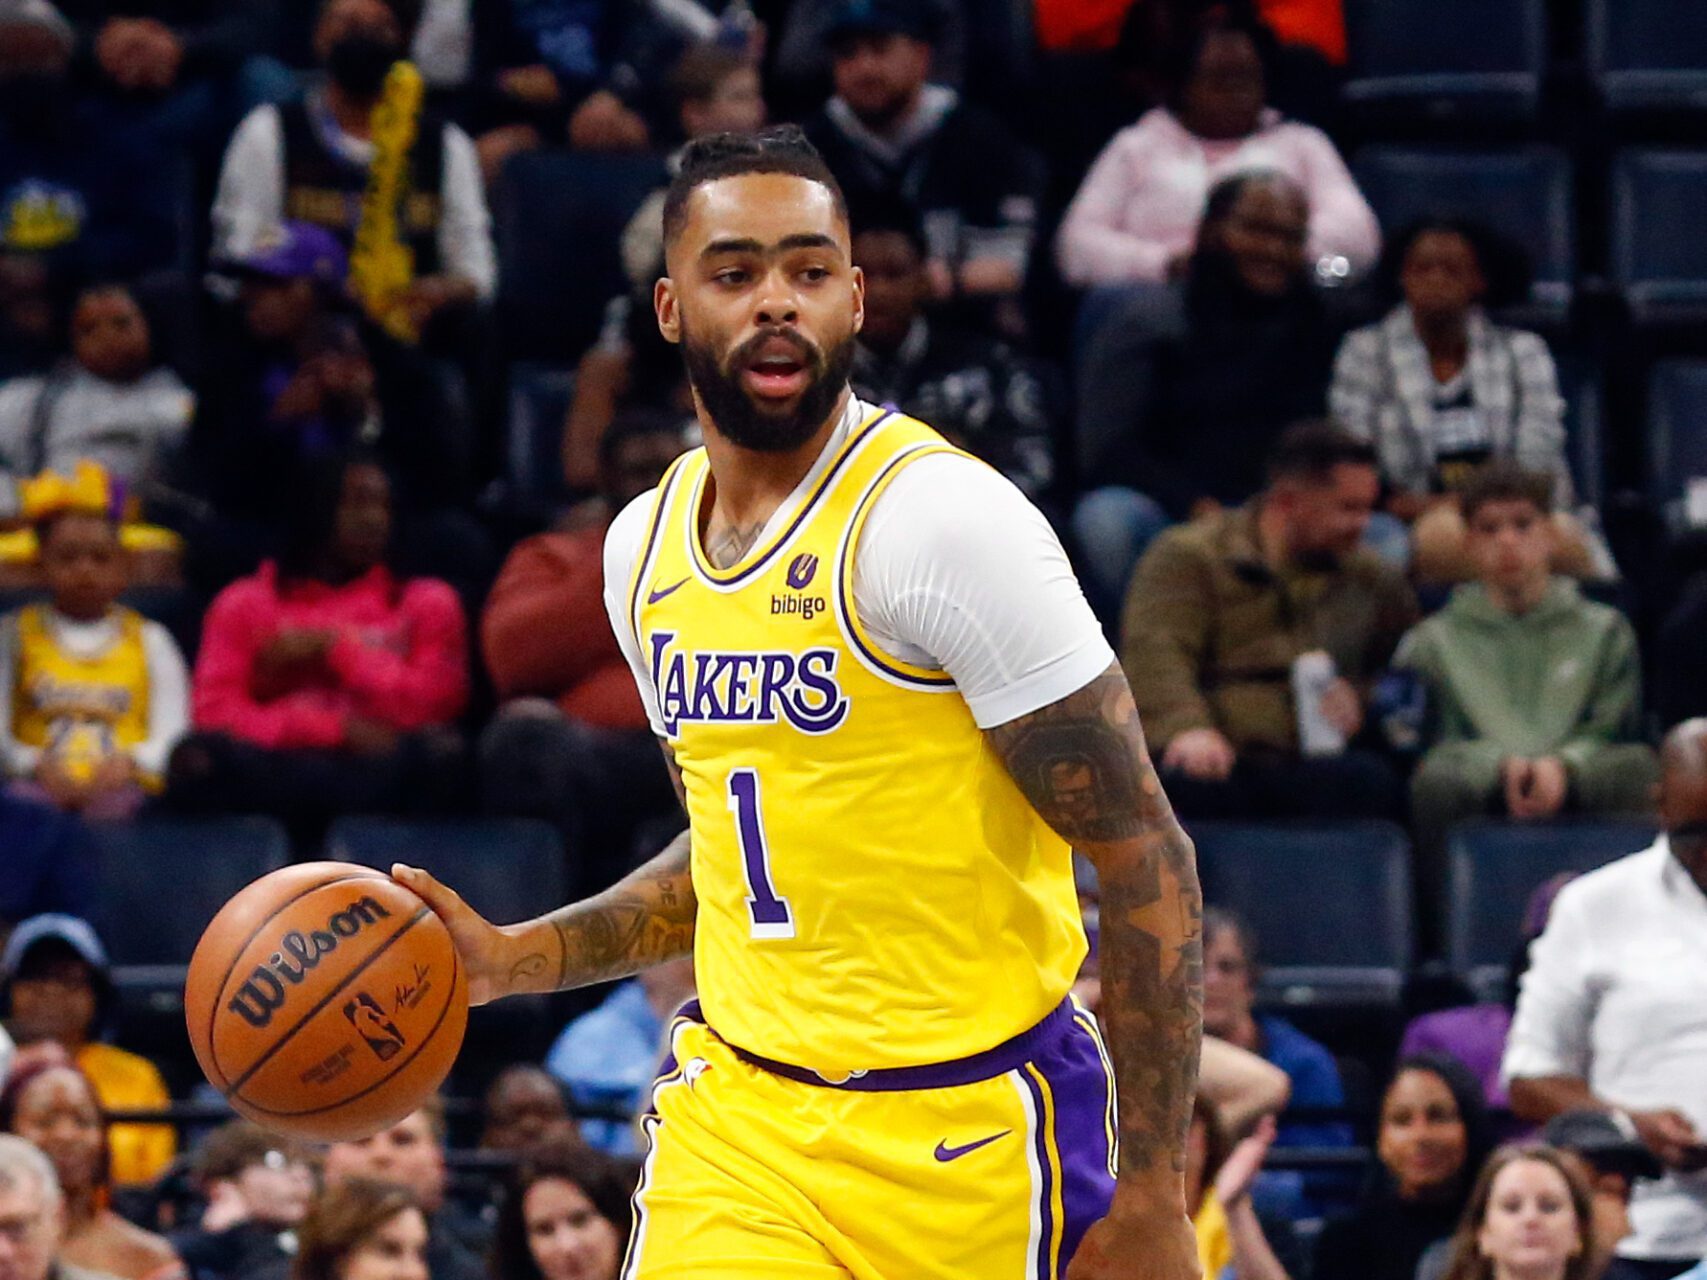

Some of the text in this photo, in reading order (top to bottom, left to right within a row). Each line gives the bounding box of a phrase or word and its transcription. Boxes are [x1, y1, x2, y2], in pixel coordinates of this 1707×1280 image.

[770, 594, 826, 620] bibigo
[650, 630, 850, 739] LAKERS
[727, 768, 795, 938] 1
[227, 895, 392, 1028] Wilson
